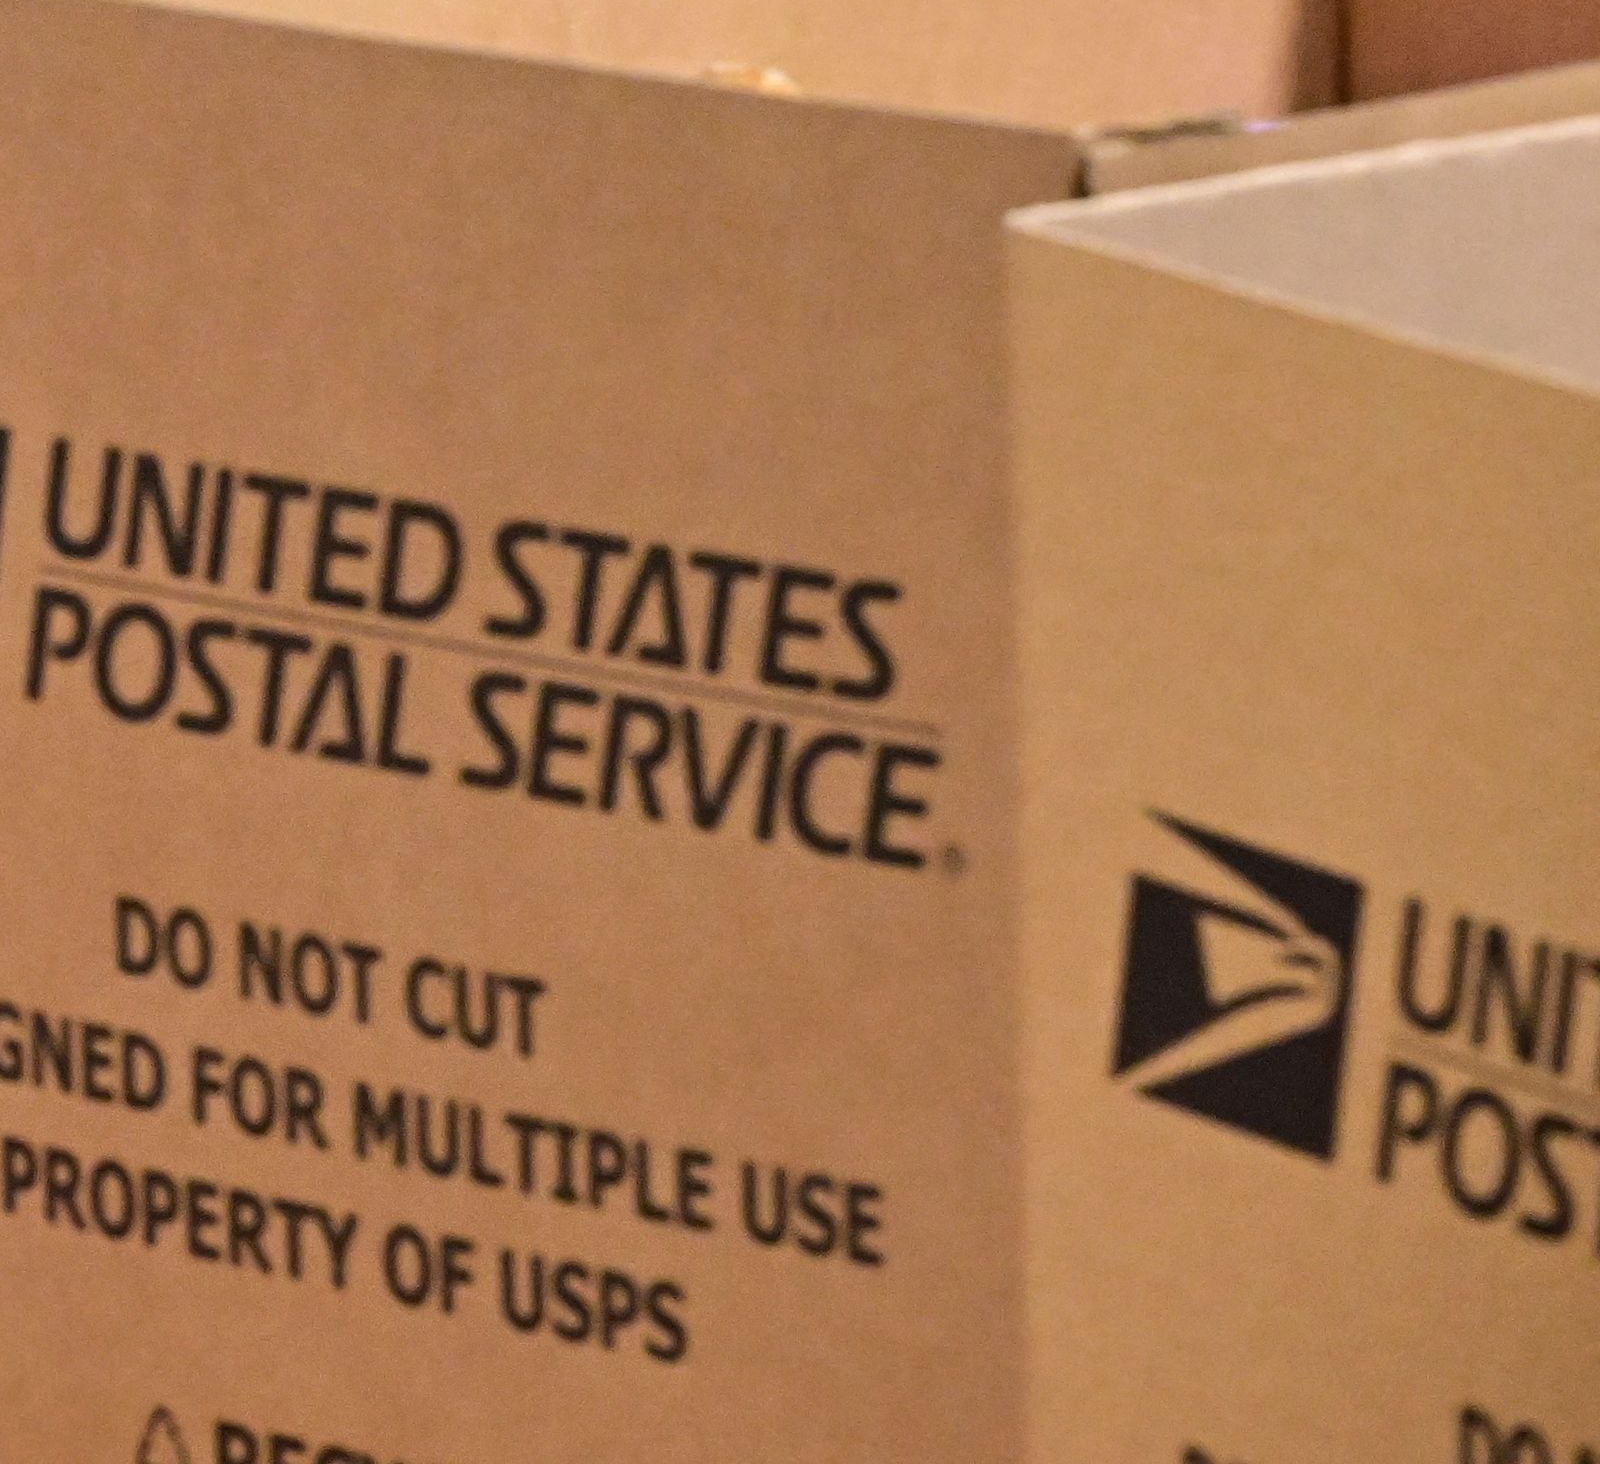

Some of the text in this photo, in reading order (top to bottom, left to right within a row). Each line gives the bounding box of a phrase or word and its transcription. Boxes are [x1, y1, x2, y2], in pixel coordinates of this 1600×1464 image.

[42, 435, 905, 703] UNITED STATES
[24, 584, 431, 780] POSTAL
[113, 894, 548, 1059] DO NOT CUT
[1396, 897, 1600, 1076] UNI
[0, 1136, 691, 1366] PROPERTY OF USPS
[192, 1044, 331, 1151] FOR
[352, 1080, 717, 1232] MULTIPLE
[740, 1160, 887, 1270] USE
[1373, 1059, 1600, 1256] POS
